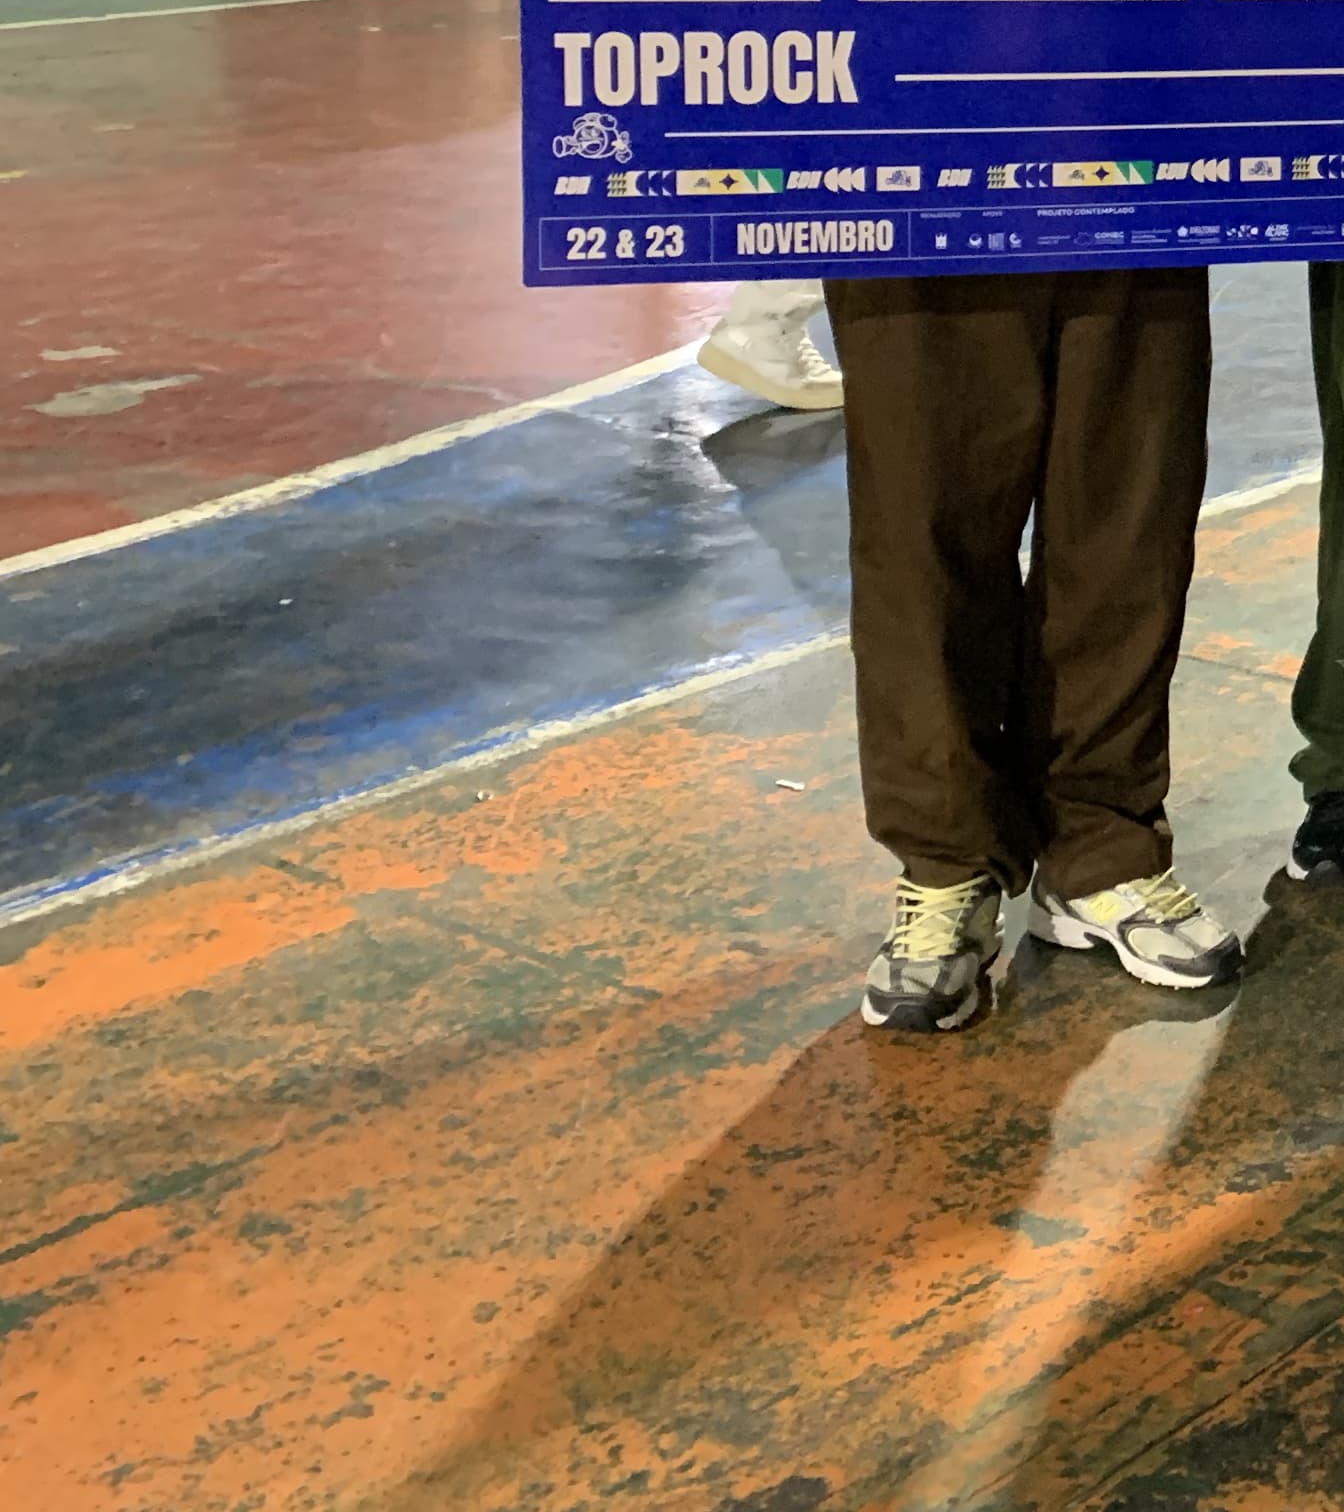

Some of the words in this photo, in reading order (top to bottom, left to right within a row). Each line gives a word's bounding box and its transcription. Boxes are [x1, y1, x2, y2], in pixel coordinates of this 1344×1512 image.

[554, 30, 859, 106] TOPROCK
[1037, 207, 1073, 218] PROJETO
[1074, 206, 1135, 217] CONTEMPLADO
[566, 227, 607, 261] 22
[615, 229, 636, 258] &
[645, 225, 685, 258] 23
[737, 219, 894, 255] NOVEMBRO
